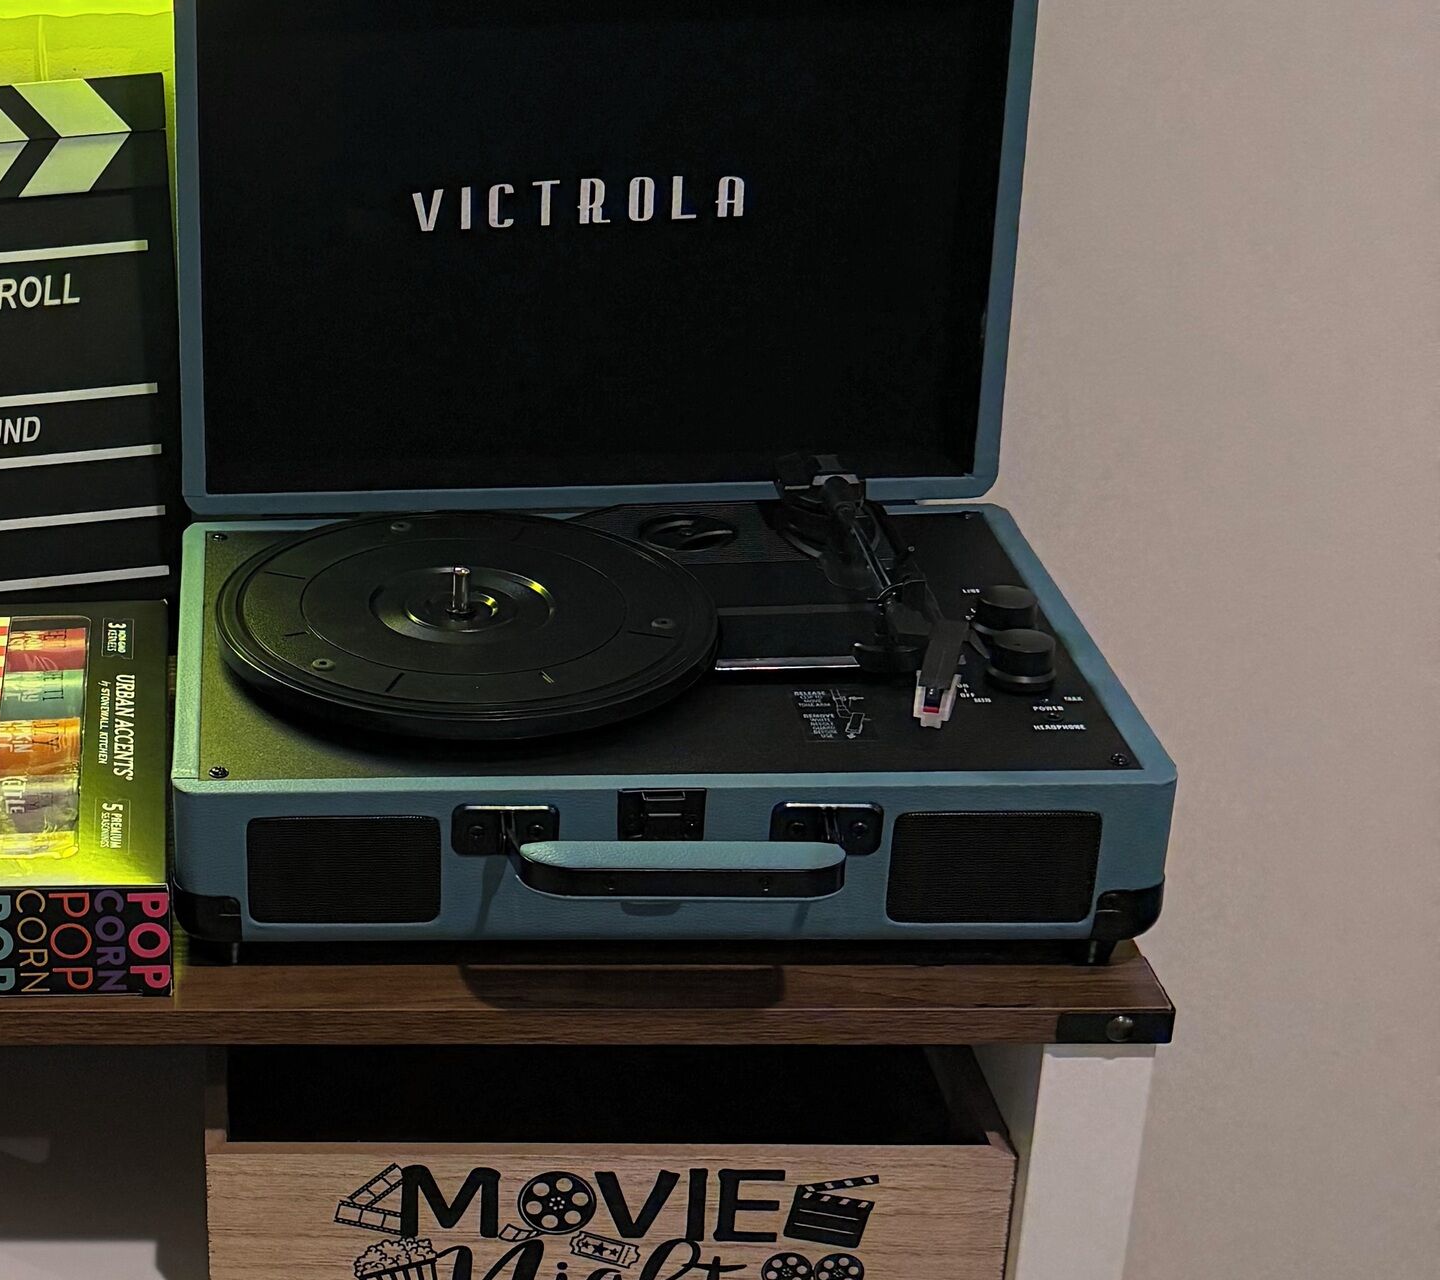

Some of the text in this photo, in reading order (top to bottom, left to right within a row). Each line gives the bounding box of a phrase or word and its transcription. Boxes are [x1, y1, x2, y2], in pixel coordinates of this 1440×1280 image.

[412, 176, 745, 232] VICTROLA
[99, 687, 111, 731] STONEWALL
[115, 674, 135, 718] URBAN
[98, 732, 109, 765] KITCHEN
[102, 802, 123, 849] 5 PREMIUM
[15, 889, 50, 992] CORN
[48, 892, 93, 990] POP
[94, 889, 127, 991] CORN
[127, 892, 171, 989] POP
[400, 1164, 786, 1242] MOVIE
